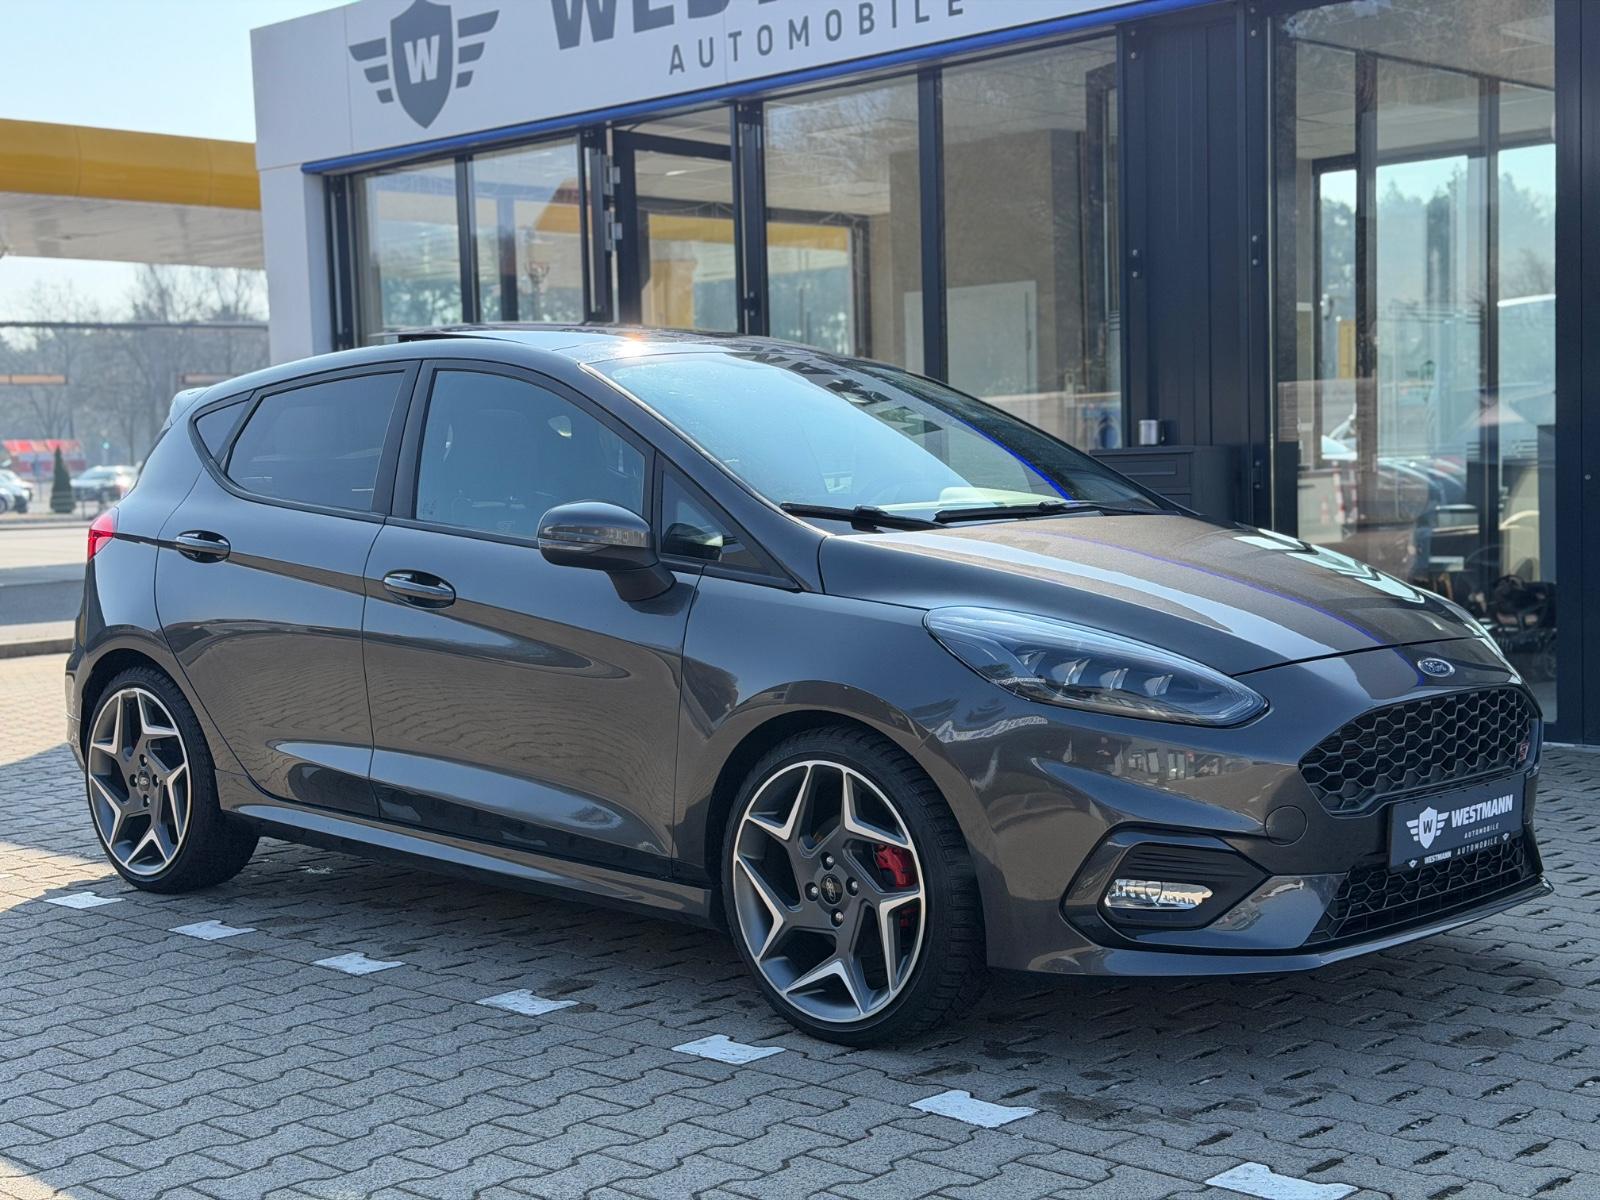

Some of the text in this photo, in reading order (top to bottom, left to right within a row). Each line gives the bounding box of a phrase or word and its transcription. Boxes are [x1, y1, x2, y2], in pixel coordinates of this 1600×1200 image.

[668, 0, 964, 75] AUTOMOBILE
[403, 35, 440, 84] W
[1451, 794, 1514, 828] WESTMANN
[1423, 819, 1434, 835] W
[1464, 822, 1500, 839] AUTOMOBILE
[1456, 836, 1499, 856] AUTOMOBILE
